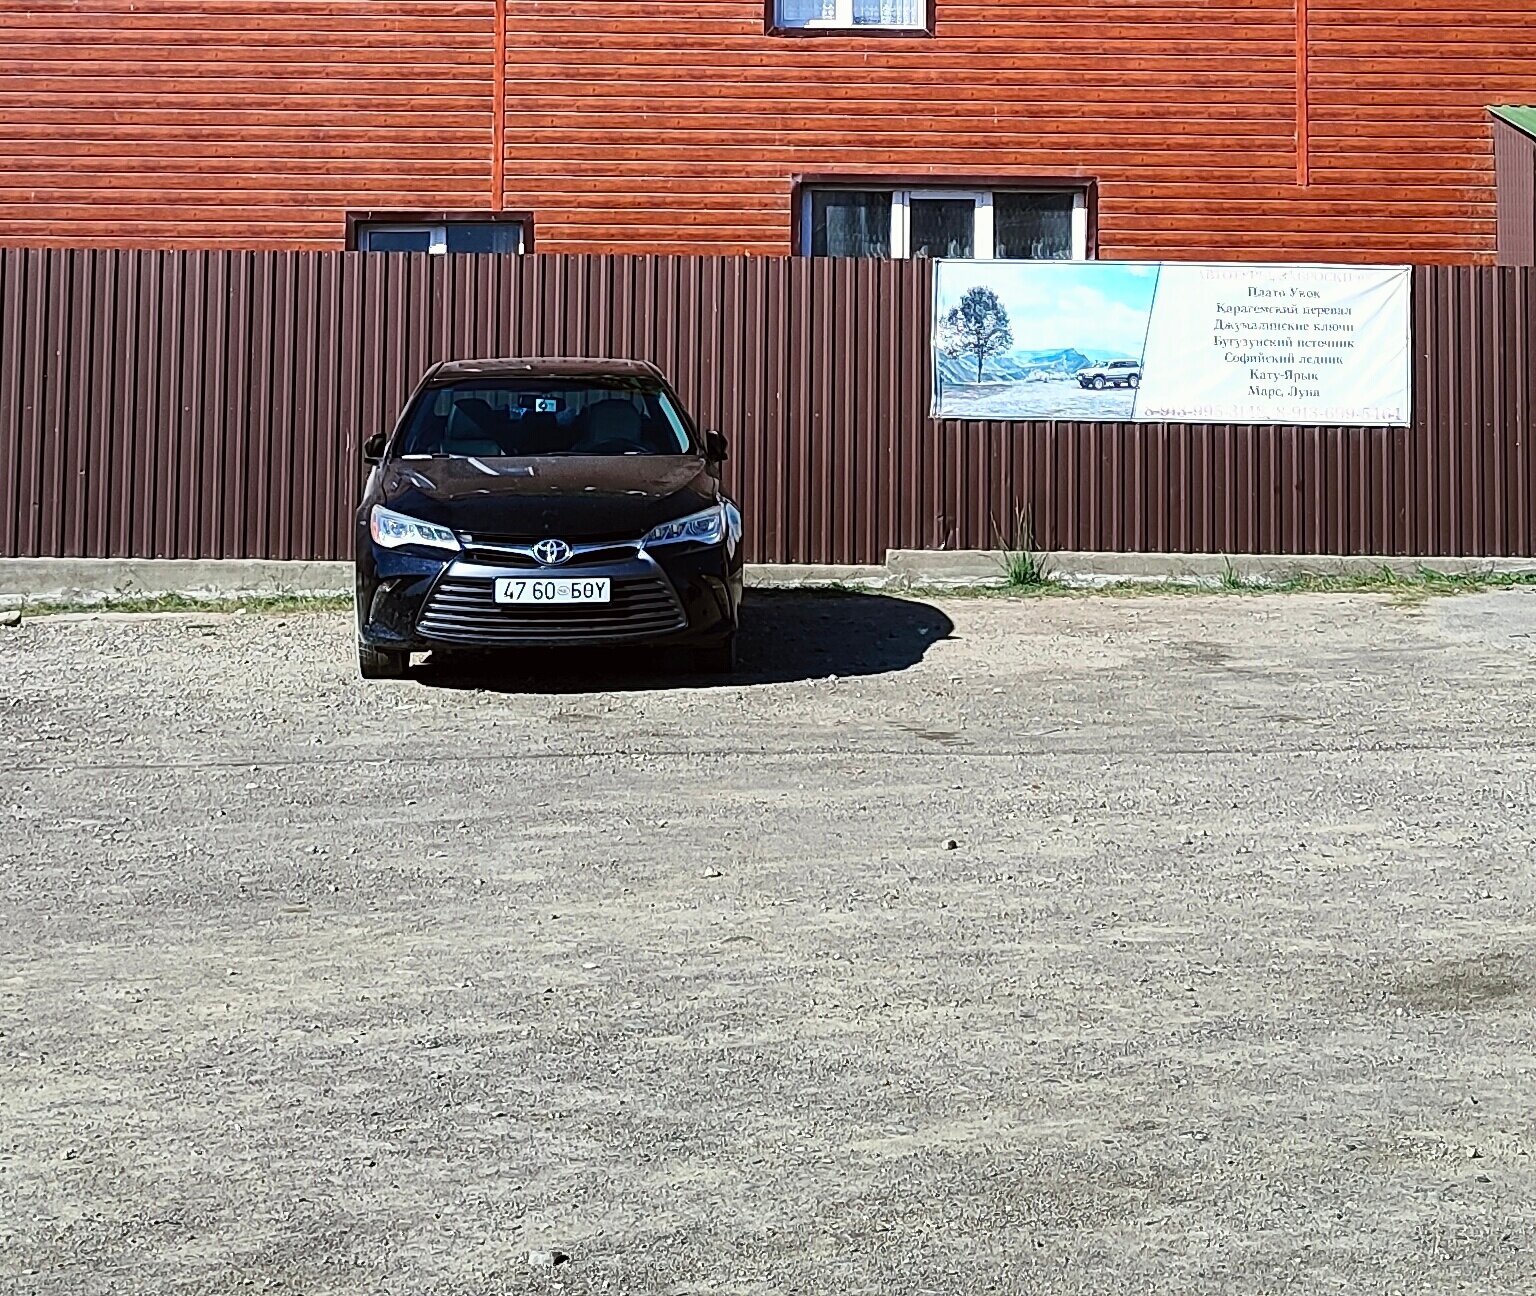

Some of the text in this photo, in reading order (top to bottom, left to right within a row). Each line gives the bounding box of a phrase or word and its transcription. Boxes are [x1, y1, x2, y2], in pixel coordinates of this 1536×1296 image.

[1248, 286, 1286, 298] Плато
[1302, 306, 1353, 317] перевал
[1313, 323, 1355, 332] ключи
[1297, 339, 1355, 348] источник
[1224, 351, 1344, 365] Софийский ледник
[1249, 368, 1319, 383] Кату-Ярык
[1248, 385, 1320, 400] Марс, Луна
